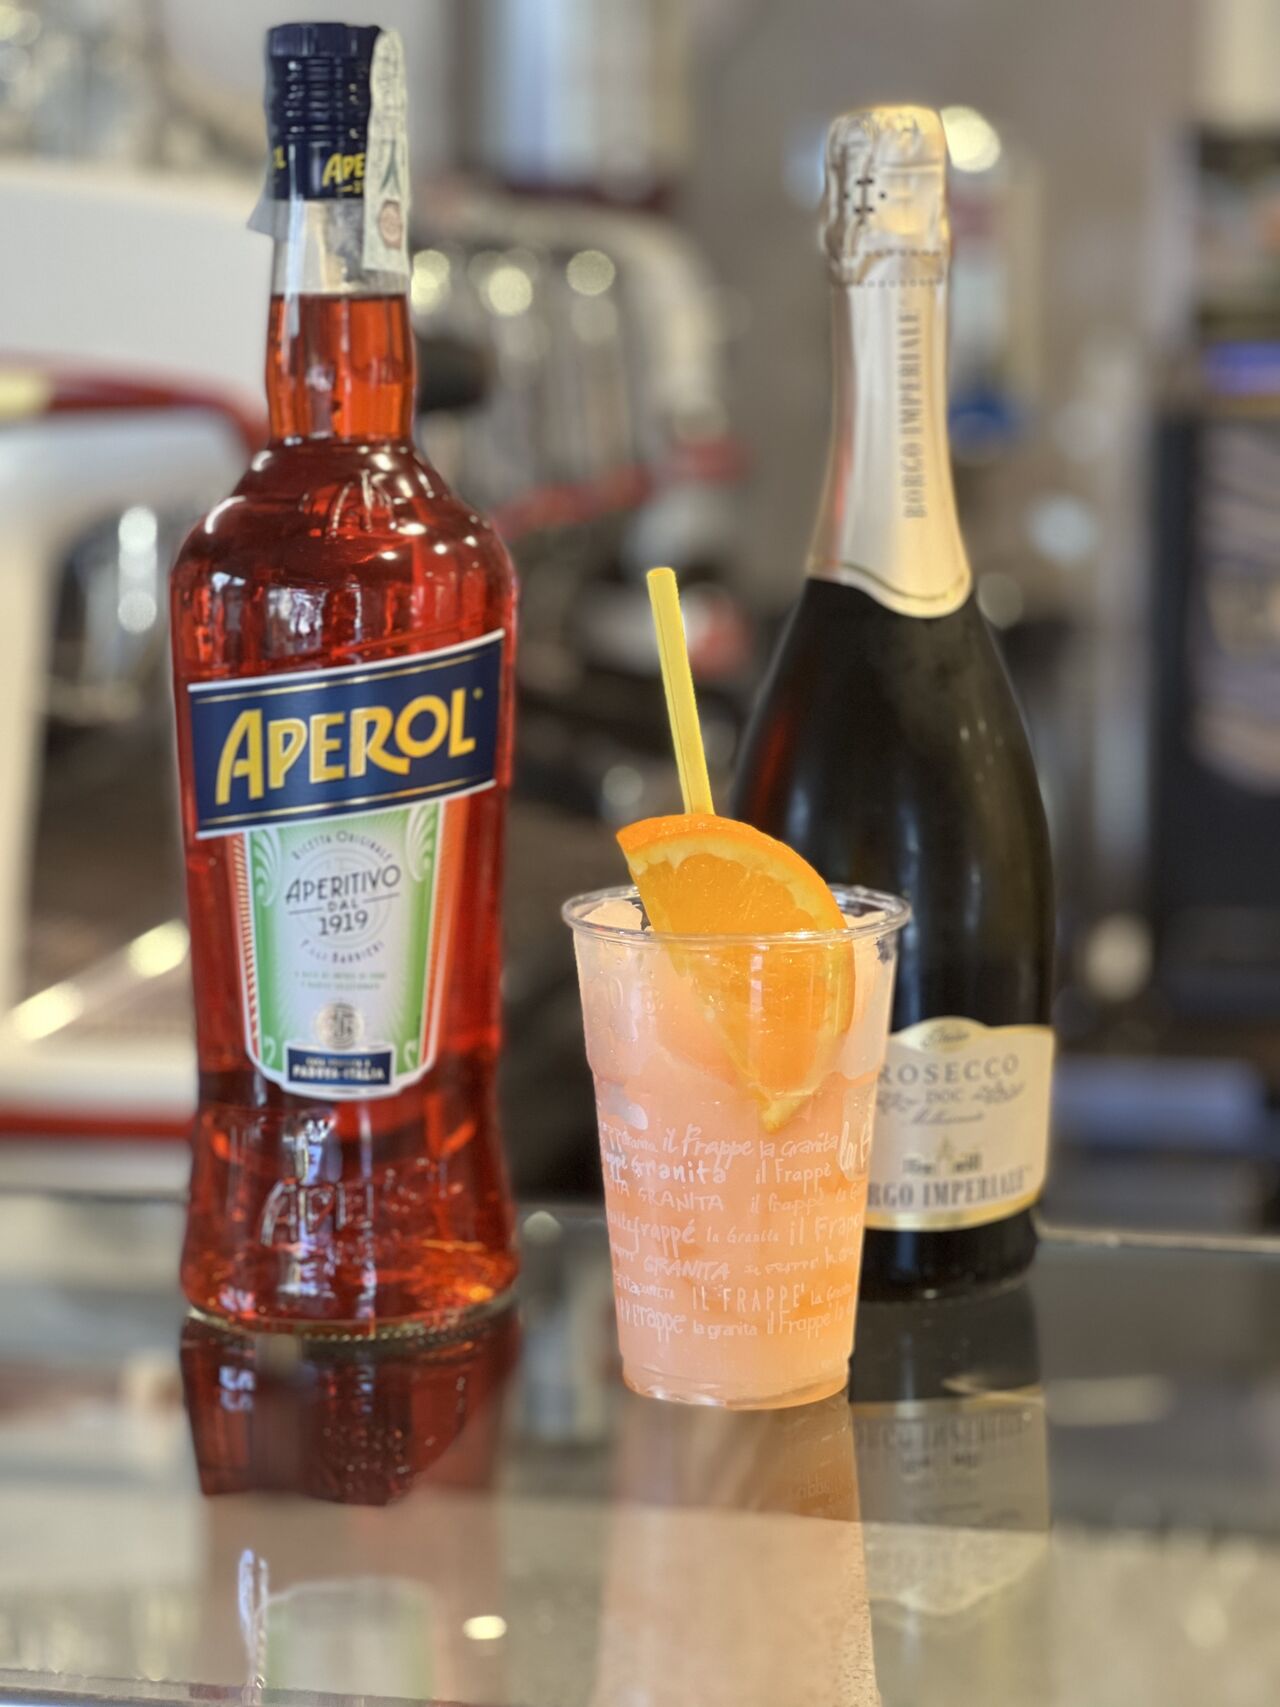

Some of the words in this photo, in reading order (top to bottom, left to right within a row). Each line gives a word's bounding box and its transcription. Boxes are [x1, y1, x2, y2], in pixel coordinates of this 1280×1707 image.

[897, 311, 923, 435] IMPERIALE
[901, 442, 927, 518] BORGO
[216, 687, 476, 806] APEROL
[286, 864, 402, 905] APERITIVO
[327, 900, 359, 913] DAL
[319, 909, 368, 936] 1919
[879, 1054, 1020, 1085] ROSECCO
[638, 1185, 724, 1213] GRANITA
[706, 1225, 720, 1244] la
[789, 1216, 805, 1246] il
[643, 1254, 731, 1281] GRANITA
[692, 1285, 710, 1312] IL
[693, 1319, 706, 1336] la
[706, 1319, 758, 1341] granita
